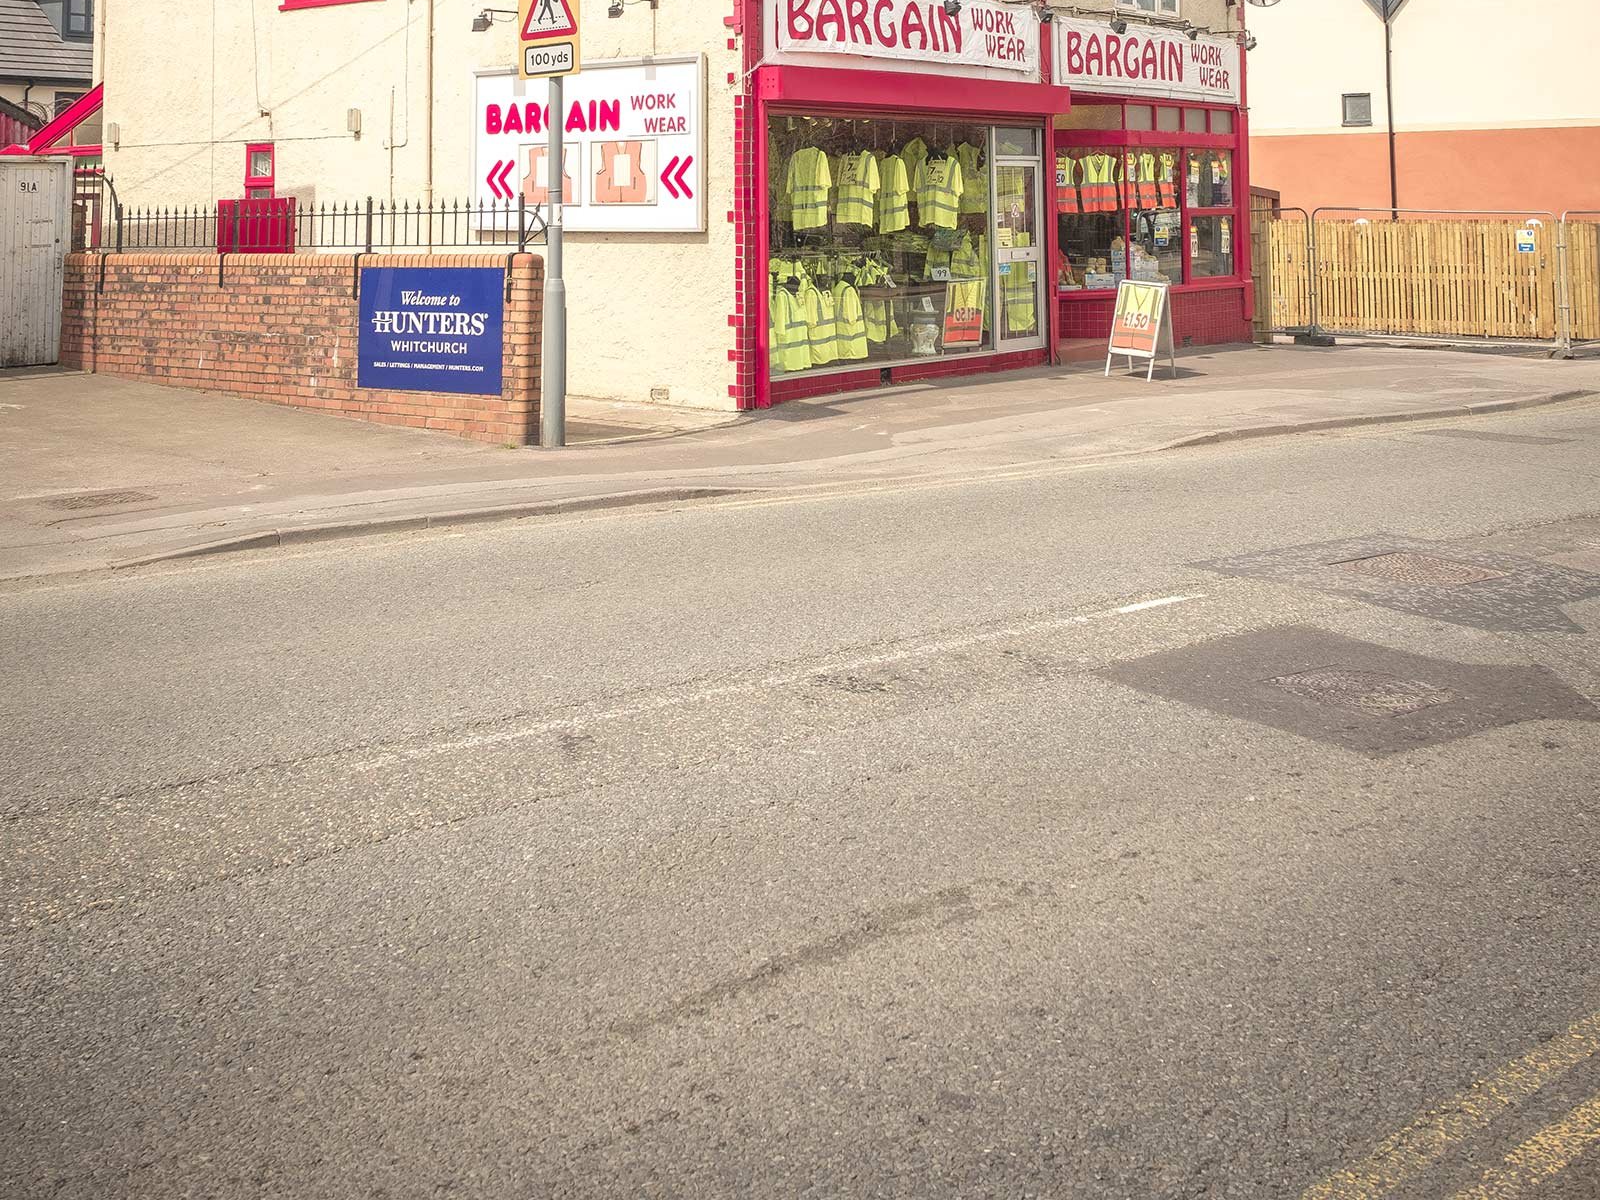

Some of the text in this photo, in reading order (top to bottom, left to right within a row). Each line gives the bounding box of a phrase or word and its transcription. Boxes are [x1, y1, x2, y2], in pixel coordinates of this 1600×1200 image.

[971, 7, 1016, 35] WORK
[985, 34, 1026, 63] WEAR
[1067, 31, 1183, 82] BARGAIN
[1190, 43, 1222, 67] WORK
[531, 50, 569, 67] 100 yds
[1199, 66, 1230, 90] WEAR
[630, 93, 677, 111] WORK
[644, 116, 687, 133] WEAR
[20, 181, 37, 193] 91A
[401, 290, 461, 306] Welcome to
[1124, 311, 1148, 329] £1.50
[390, 340, 467, 355] WHITCHURCH
[413, 363, 446, 371] MANAGEMENT
[448, 365, 484, 373] HUNTERS.COM
